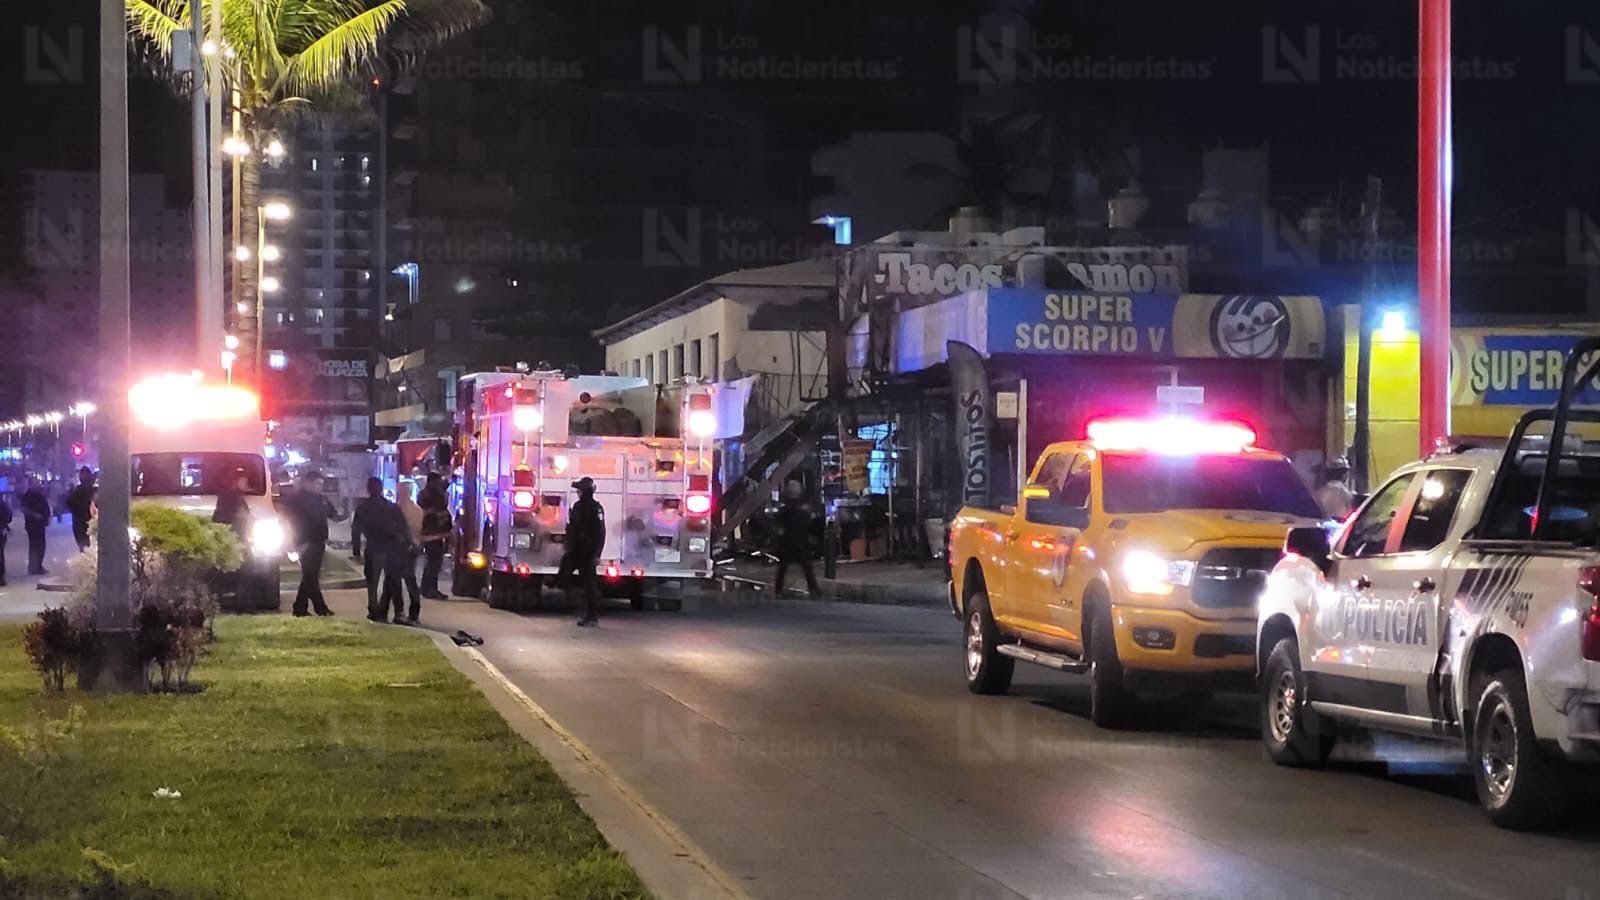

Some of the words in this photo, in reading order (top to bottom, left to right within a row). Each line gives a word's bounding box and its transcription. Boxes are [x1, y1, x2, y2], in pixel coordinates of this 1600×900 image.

[877, 252, 1002, 294] Tacos
[1045, 294, 1133, 322] SUPER
[1015, 323, 1138, 352] SCORPIO
[1148, 327, 1166, 353] V
[1471, 349, 1564, 394] SUPER
[1343, 590, 1429, 646] POLICÍA
